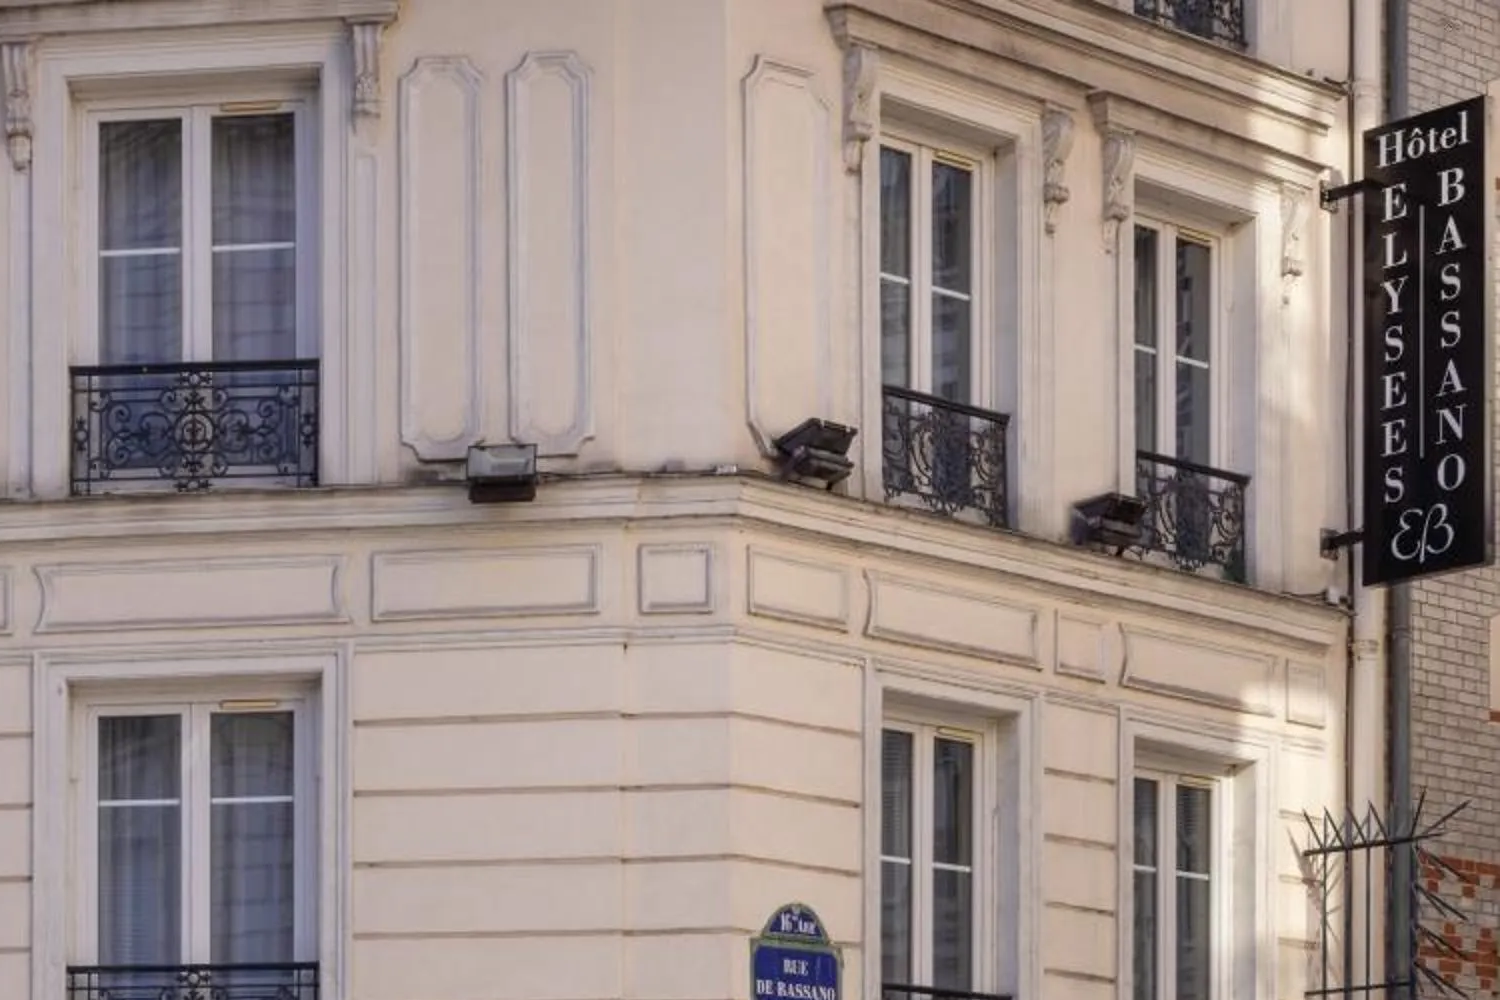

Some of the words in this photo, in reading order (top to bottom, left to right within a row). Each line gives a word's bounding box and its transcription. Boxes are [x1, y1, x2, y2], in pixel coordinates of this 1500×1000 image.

[1376, 110, 1469, 169] Hôtel
[1381, 182, 1408, 505] ELYSEES
[1435, 167, 1466, 491] BASSANO
[756, 979, 773, 994] DE
[783, 958, 808, 976] RUE
